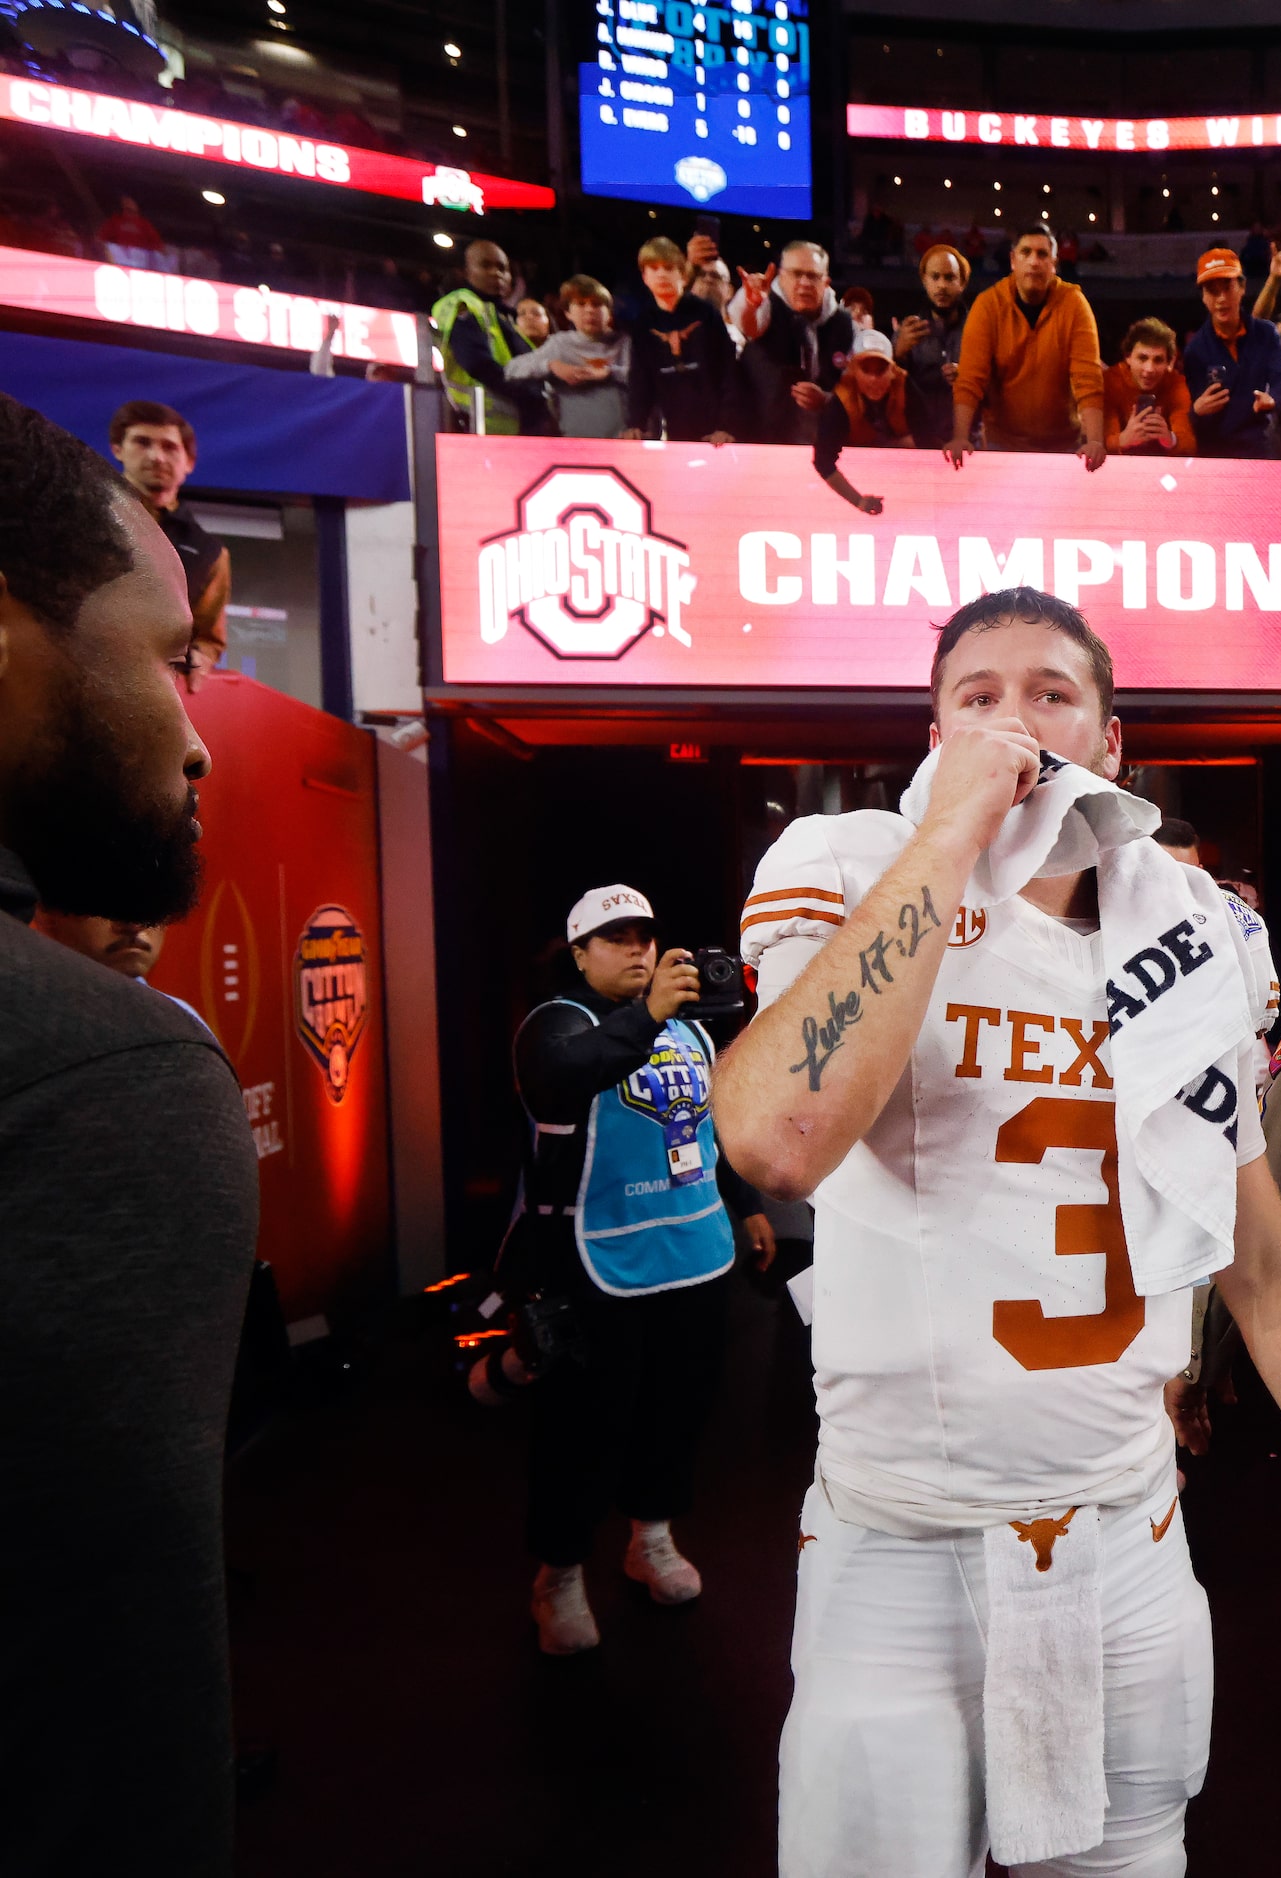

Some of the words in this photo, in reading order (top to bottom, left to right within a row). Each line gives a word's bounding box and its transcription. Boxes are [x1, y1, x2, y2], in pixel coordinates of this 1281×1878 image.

[9, 80, 350, 183] CHAMPIONS
[904, 109, 1169, 149] BUCKEYES
[94, 265, 219, 335] OHIO
[1106, 919, 1214, 1041] ADE
[790, 990, 864, 1091] Luke
[945, 1003, 1114, 1090] TEX
[993, 1097, 1147, 1371] 3
